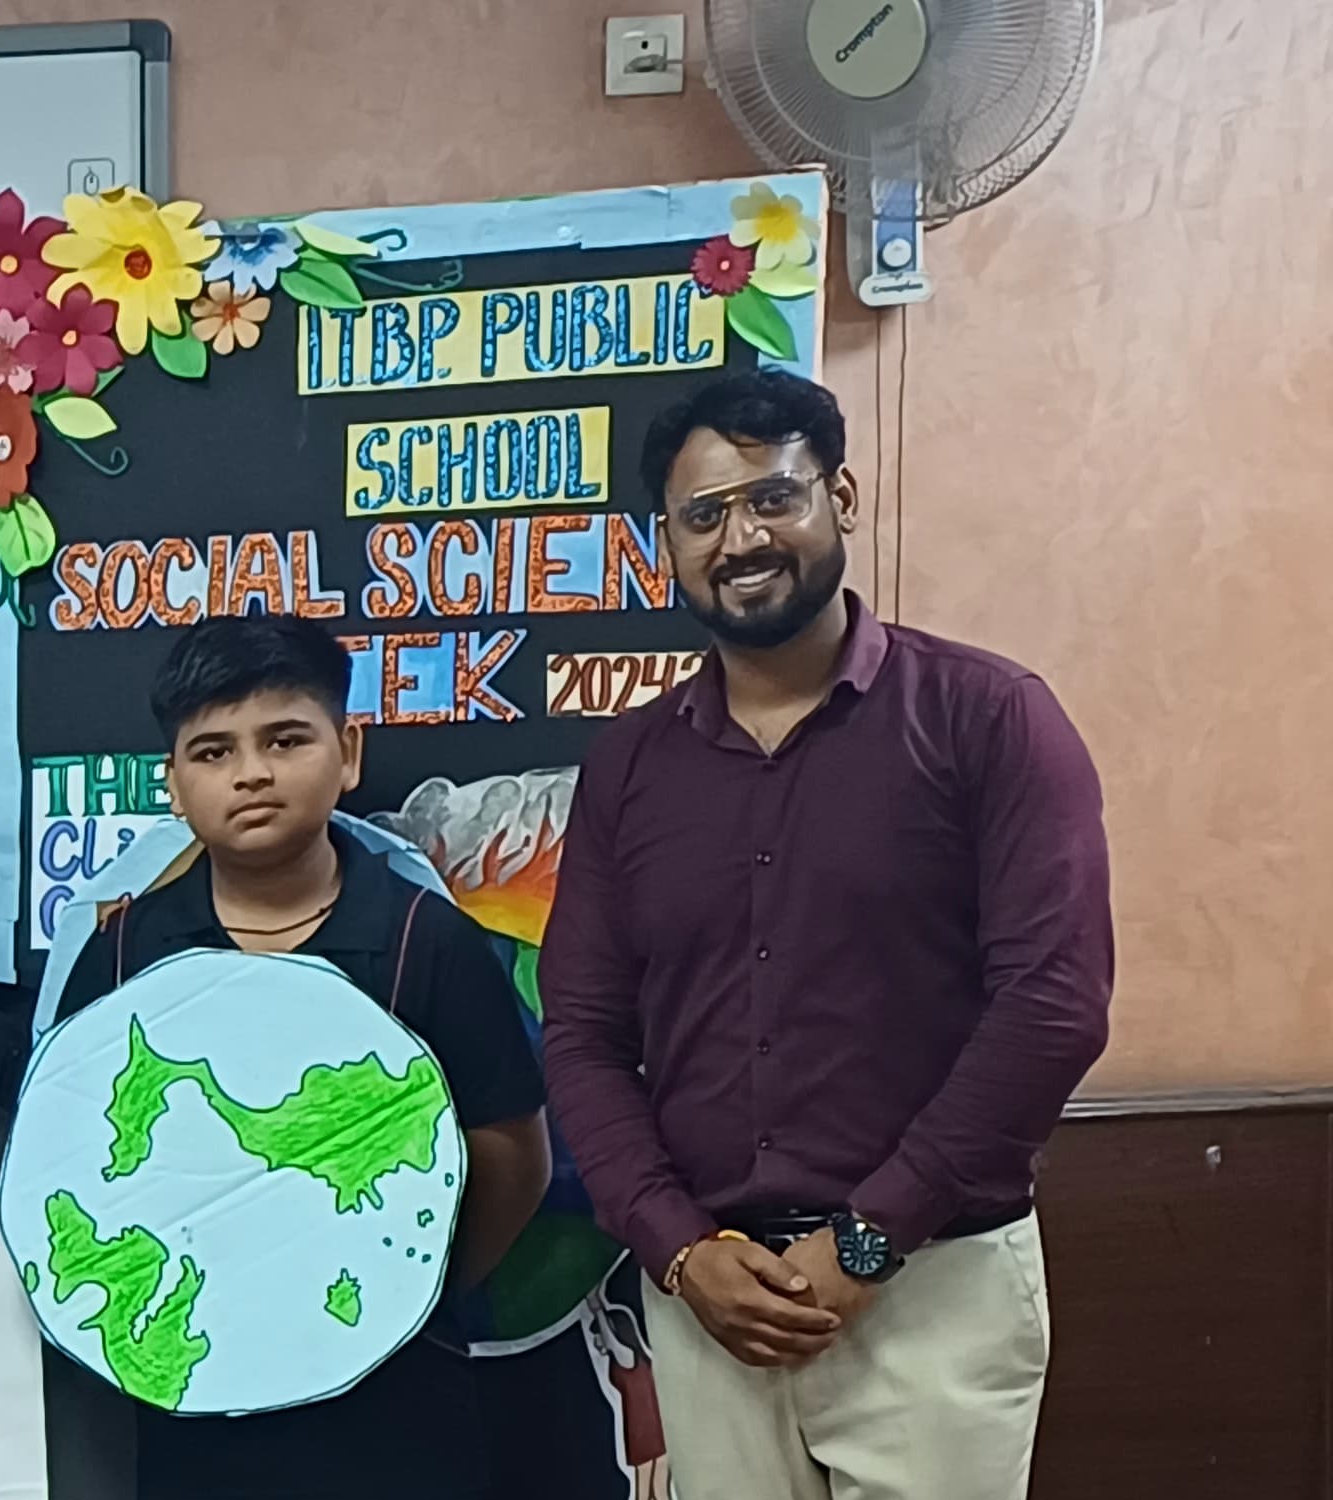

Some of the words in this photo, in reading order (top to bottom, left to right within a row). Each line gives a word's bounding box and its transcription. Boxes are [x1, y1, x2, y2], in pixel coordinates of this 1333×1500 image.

[834, 3, 894, 64] Crompton
[480, 278, 714, 378] PUBLIC
[352, 412, 601, 511] SCHOOL
[52, 529, 345, 630] SOCIAL
[363, 514, 675, 620] SCIEN
